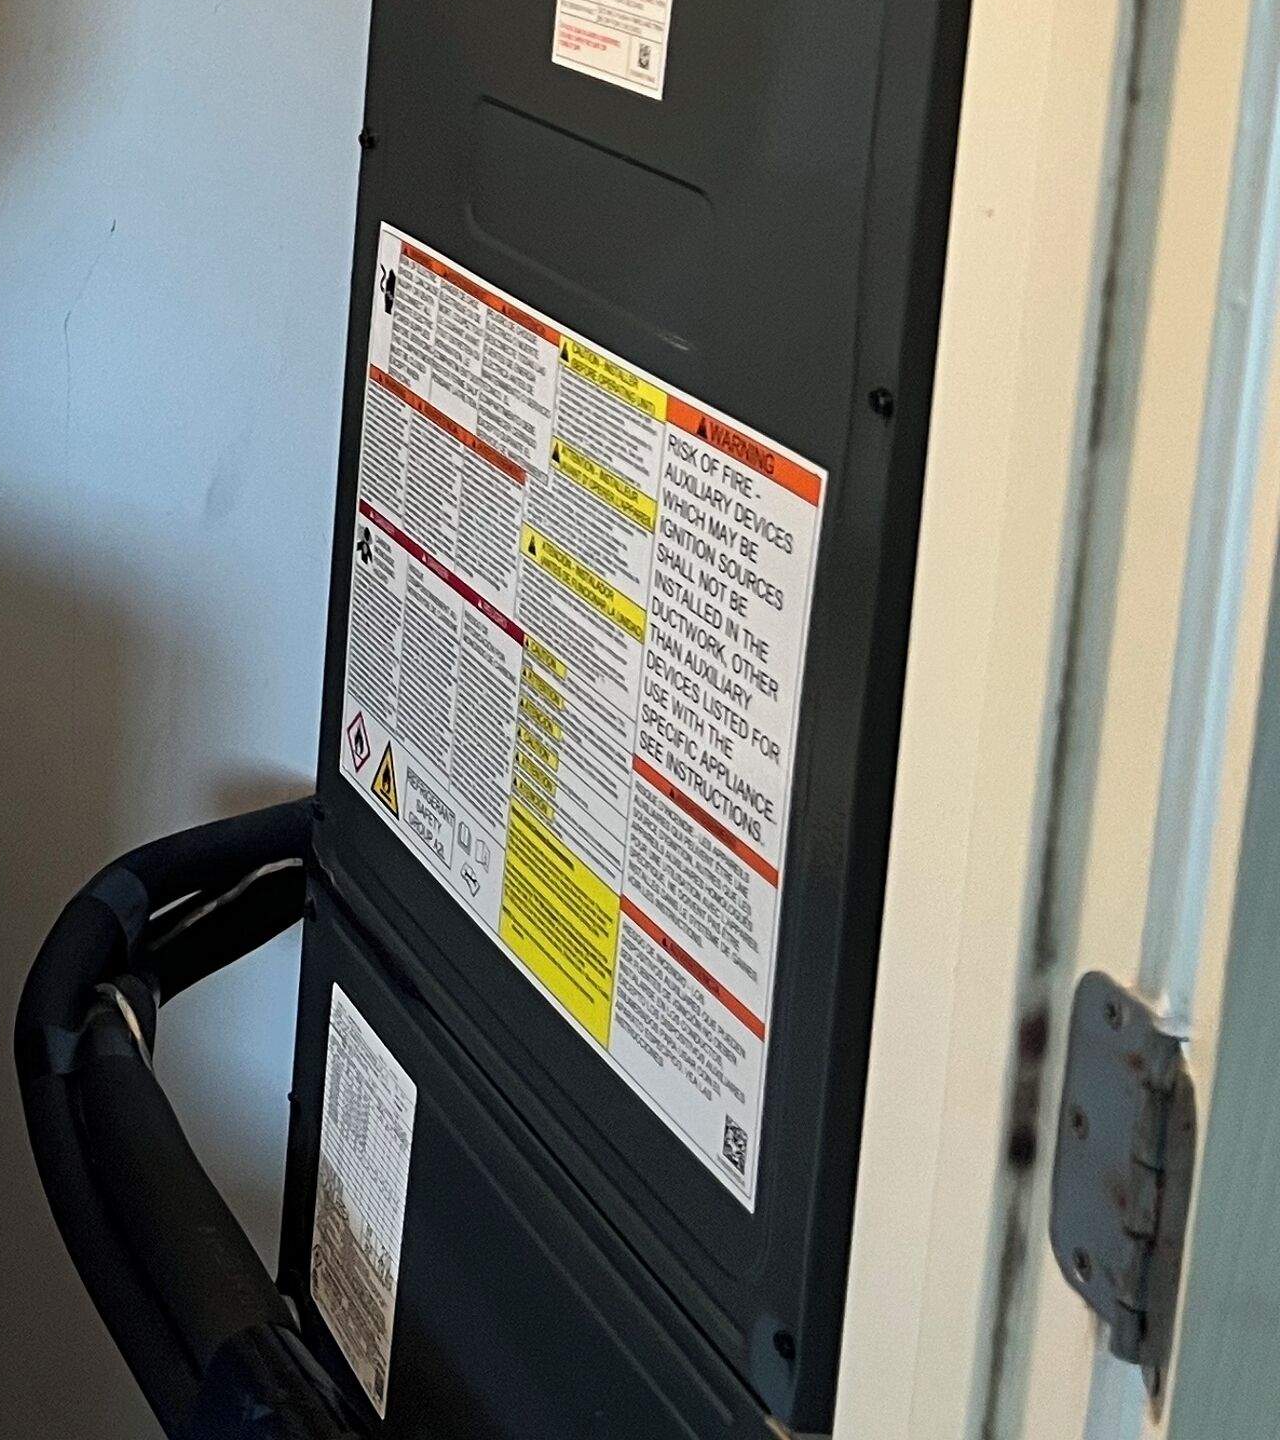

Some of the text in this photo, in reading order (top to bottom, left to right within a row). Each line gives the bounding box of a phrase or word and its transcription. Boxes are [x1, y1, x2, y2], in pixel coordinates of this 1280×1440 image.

[667, 433, 697, 466] RISK
[700, 452, 719, 479] OF
[722, 465, 752, 499] FIRE
[708, 421, 774, 475] WARNING
[661, 486, 758, 564] WHICH MAY BE
[664, 459, 793, 555] AUXILIARY DEVICES
[656, 540, 747, 618] SHALL NOT BE
[659, 514, 783, 611] IGNITION SOURCES
[651, 595, 778, 702] DUCTWORK, OTHER
[654, 568, 768, 663] INSTALLED IN THE
[646, 648, 779, 765] DEVICES LISTED FOR
[649, 622, 751, 712] THAN AUXILIARY
[641, 701, 696, 761] SPECIFIC
[699, 748, 778, 826] APPLIANCE.
[644, 675, 733, 760] USE WITH THE
[639, 728, 663, 763] SEE
[665, 750, 765, 847] INSTRUCTIONS.
